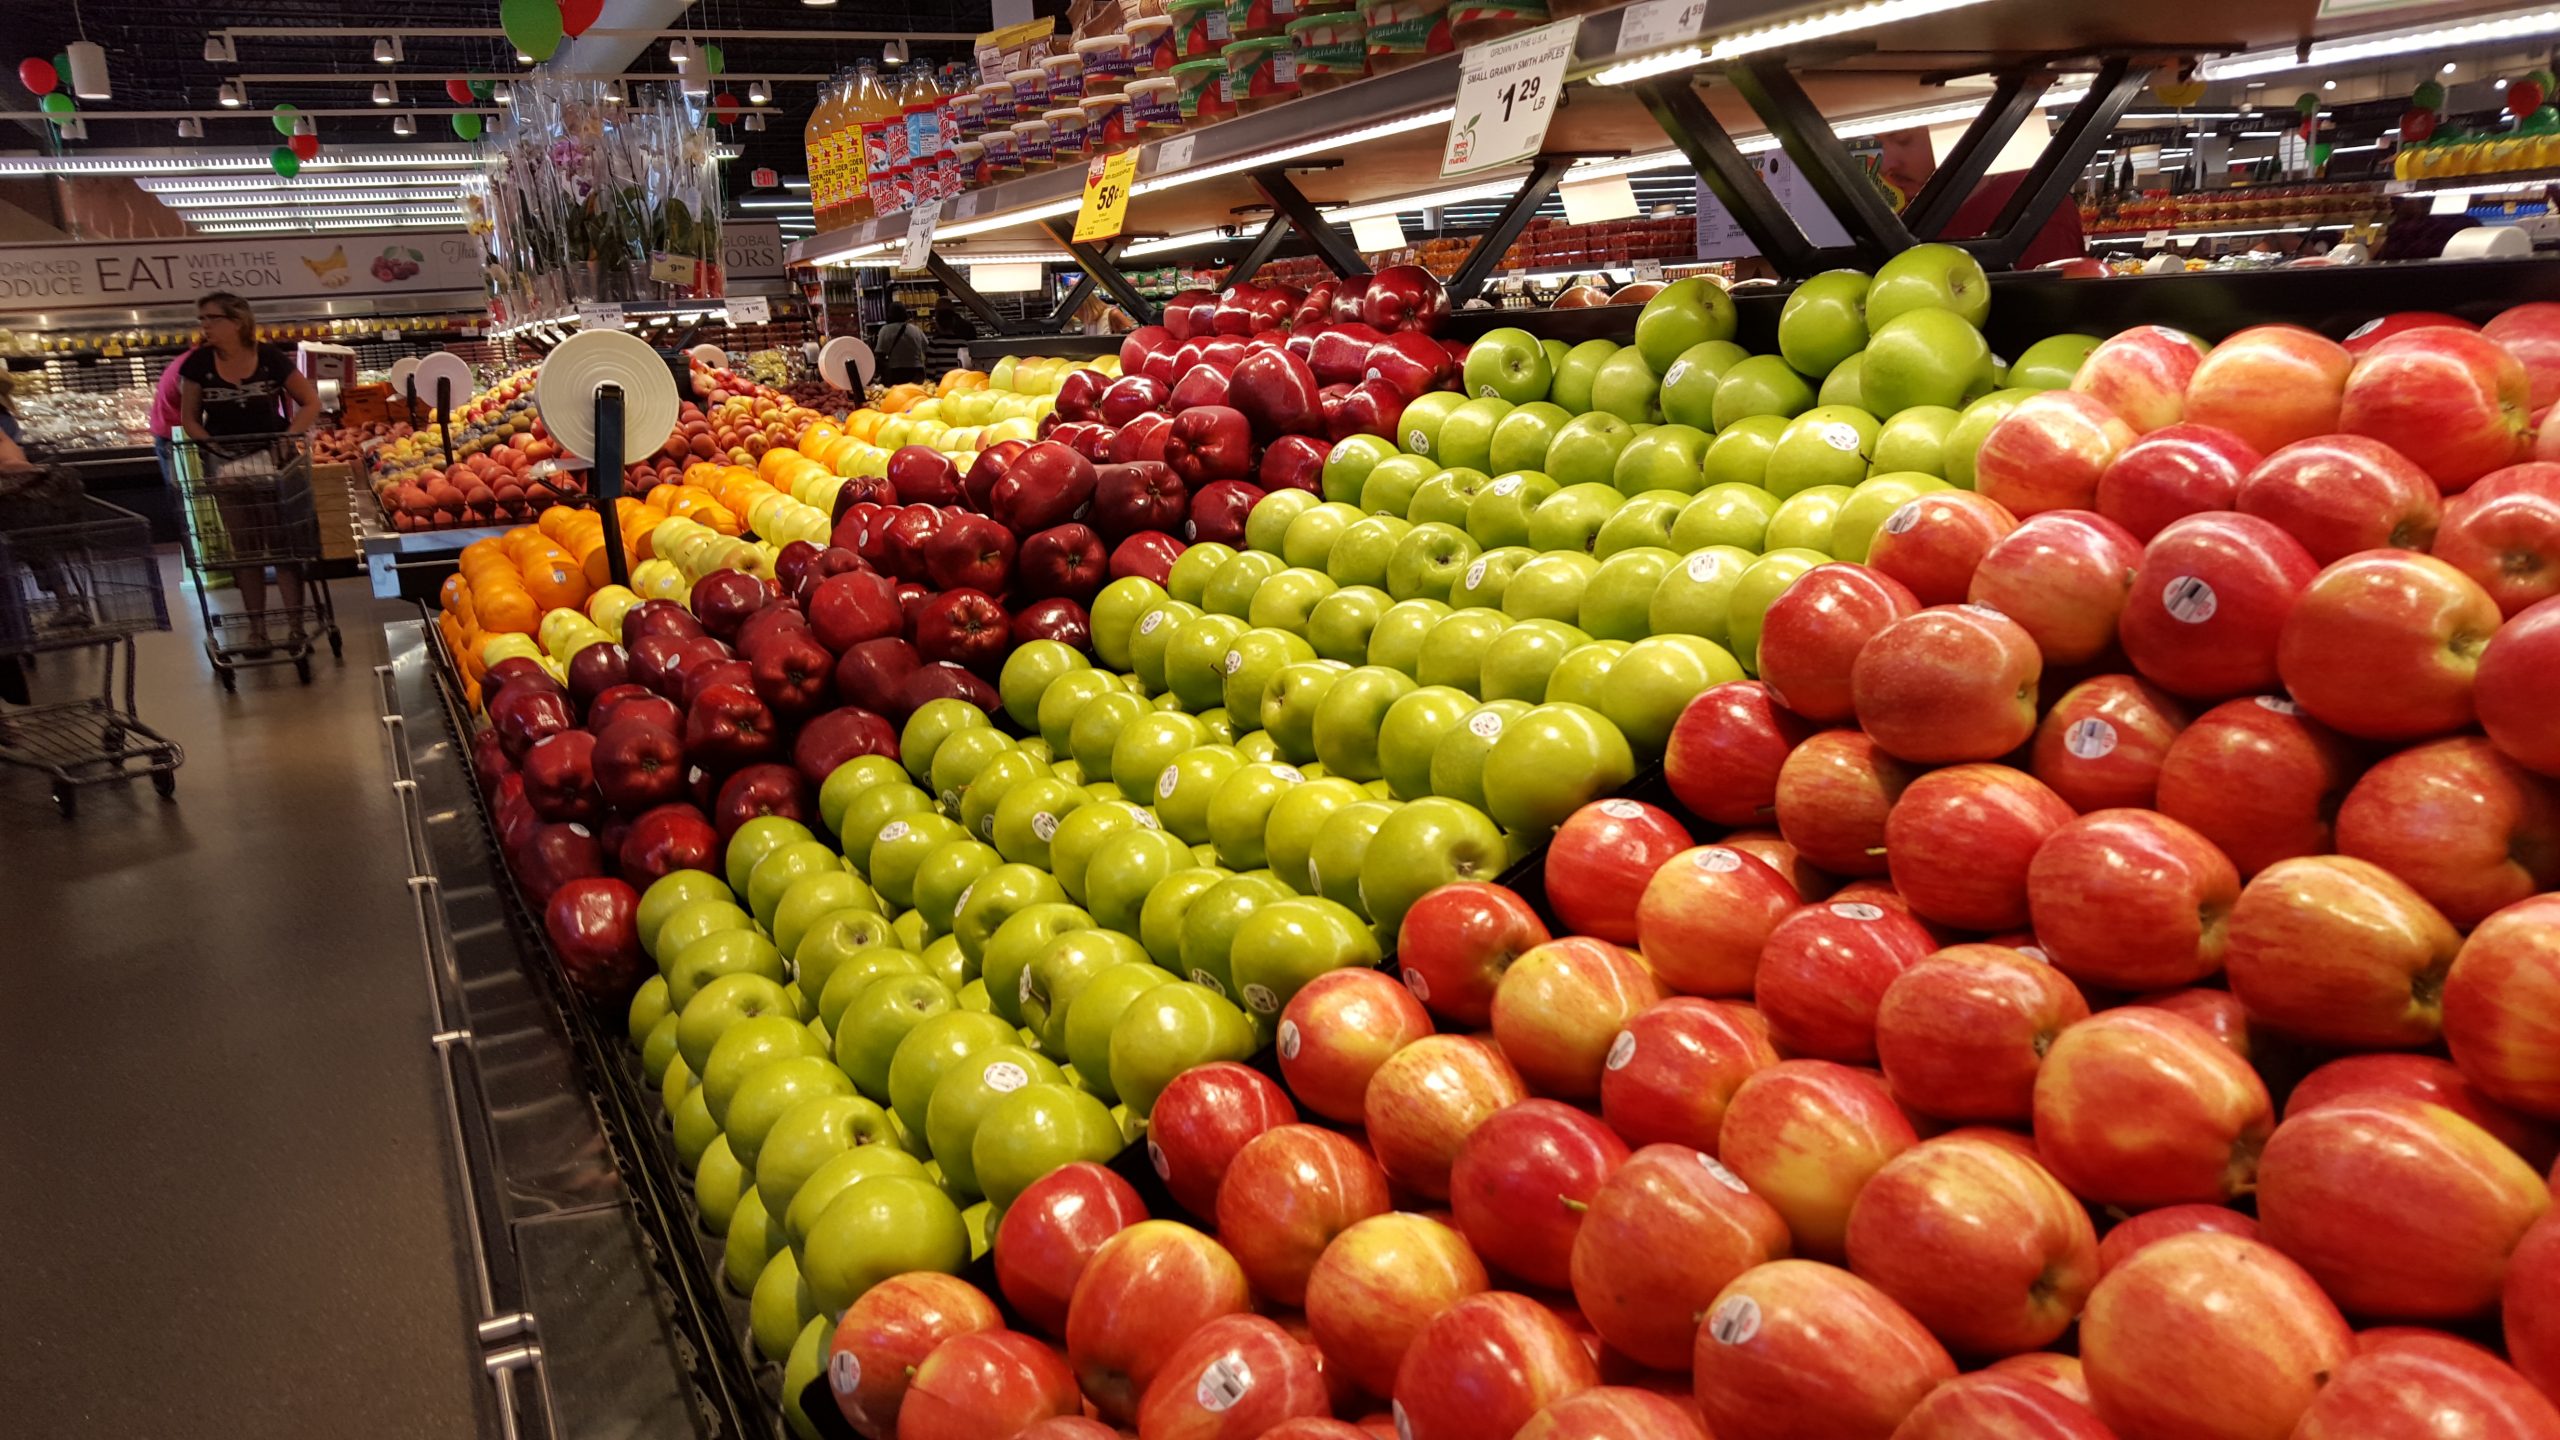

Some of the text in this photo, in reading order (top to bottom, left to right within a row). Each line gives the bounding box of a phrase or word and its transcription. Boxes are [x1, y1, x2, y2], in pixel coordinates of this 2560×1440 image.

[1490, 44, 1512, 58] GROWN
[1512, 43, 1520, 51] IN
[1520, 38, 1532, 50] THE
[1466, 46, 1566, 85] SMALL GRANNY SMITH APPLES
[1532, 96, 1546, 112] LB
[184, 250, 276, 270] WITH THE
[96, 255, 180, 292] EAT
[188, 268, 282, 290] SEASON
